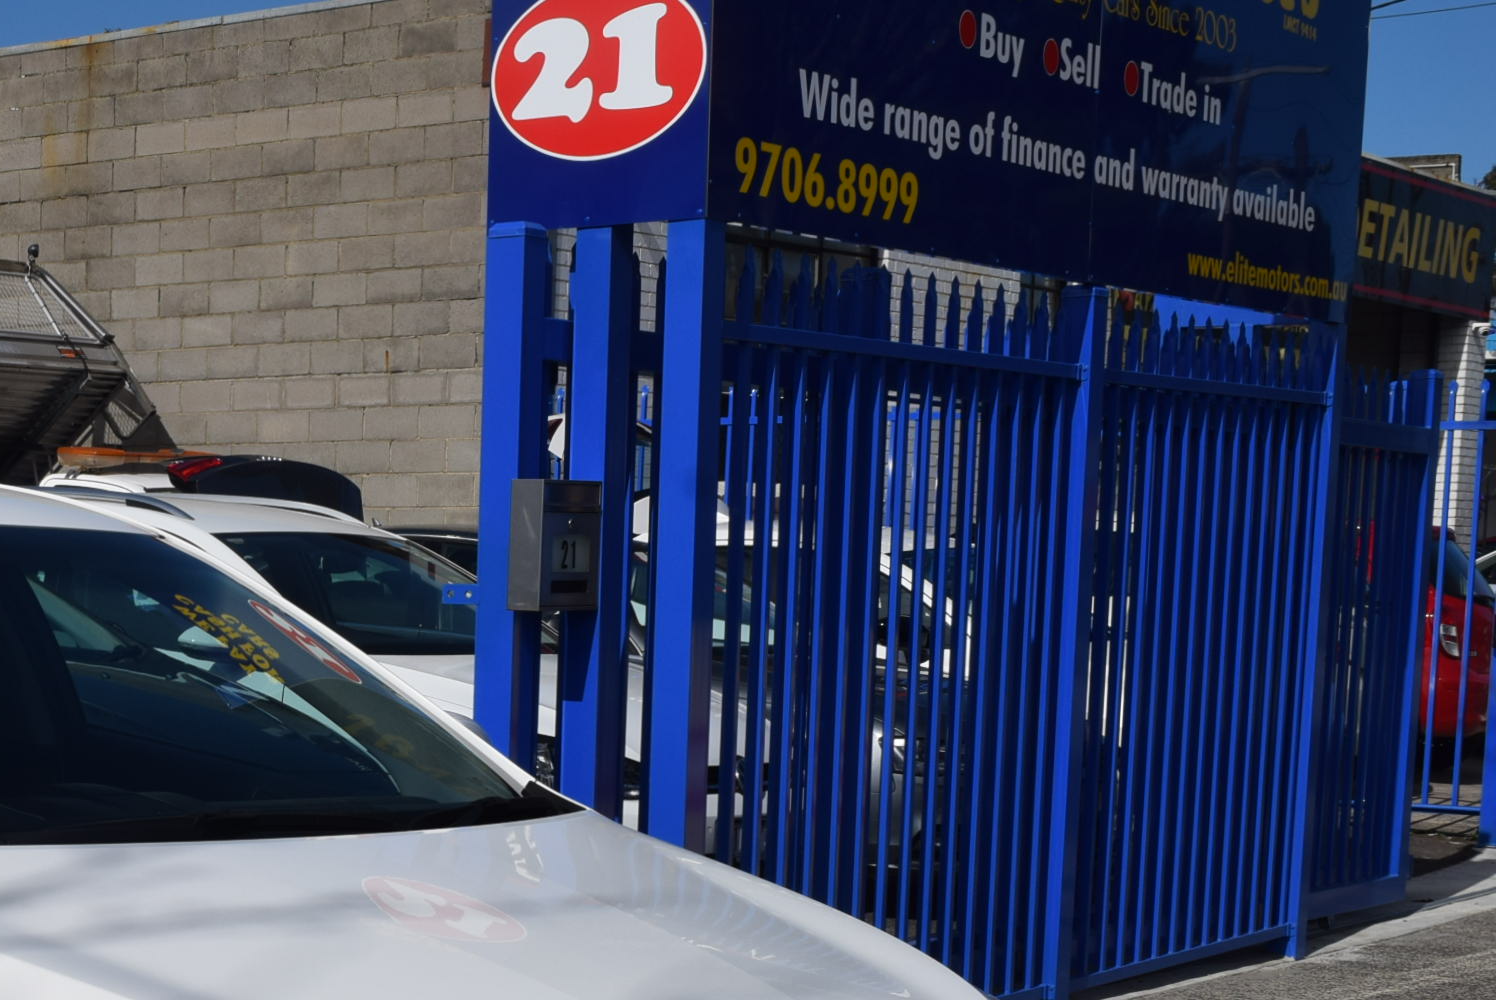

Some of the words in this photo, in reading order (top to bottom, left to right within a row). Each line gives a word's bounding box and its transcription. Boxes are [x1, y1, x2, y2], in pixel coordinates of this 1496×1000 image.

[979, 12, 1025, 77] Buy
[1146, 0, 1190, 36] Since
[1195, 7, 1237, 52] 2003
[512, 2, 673, 123] 21
[1060, 37, 1102, 89] Sell
[1141, 62, 1197, 117] Trade
[1204, 84, 1222, 125] in
[735, 137, 919, 224] 9706.8999
[799, 68, 875, 131] Wide
[883, 102, 960, 160] range
[969, 112, 995, 157] of
[1002, 116, 1086, 180] finance
[1094, 148, 1135, 191] and
[1142, 165, 1228, 221] warranty
[1233, 184, 1316, 232] available
[1356, 198, 1481, 285] ETAILING
[1188, 251, 1348, 302] www.elitemotors.com.au
[561, 540, 576, 569] 21
